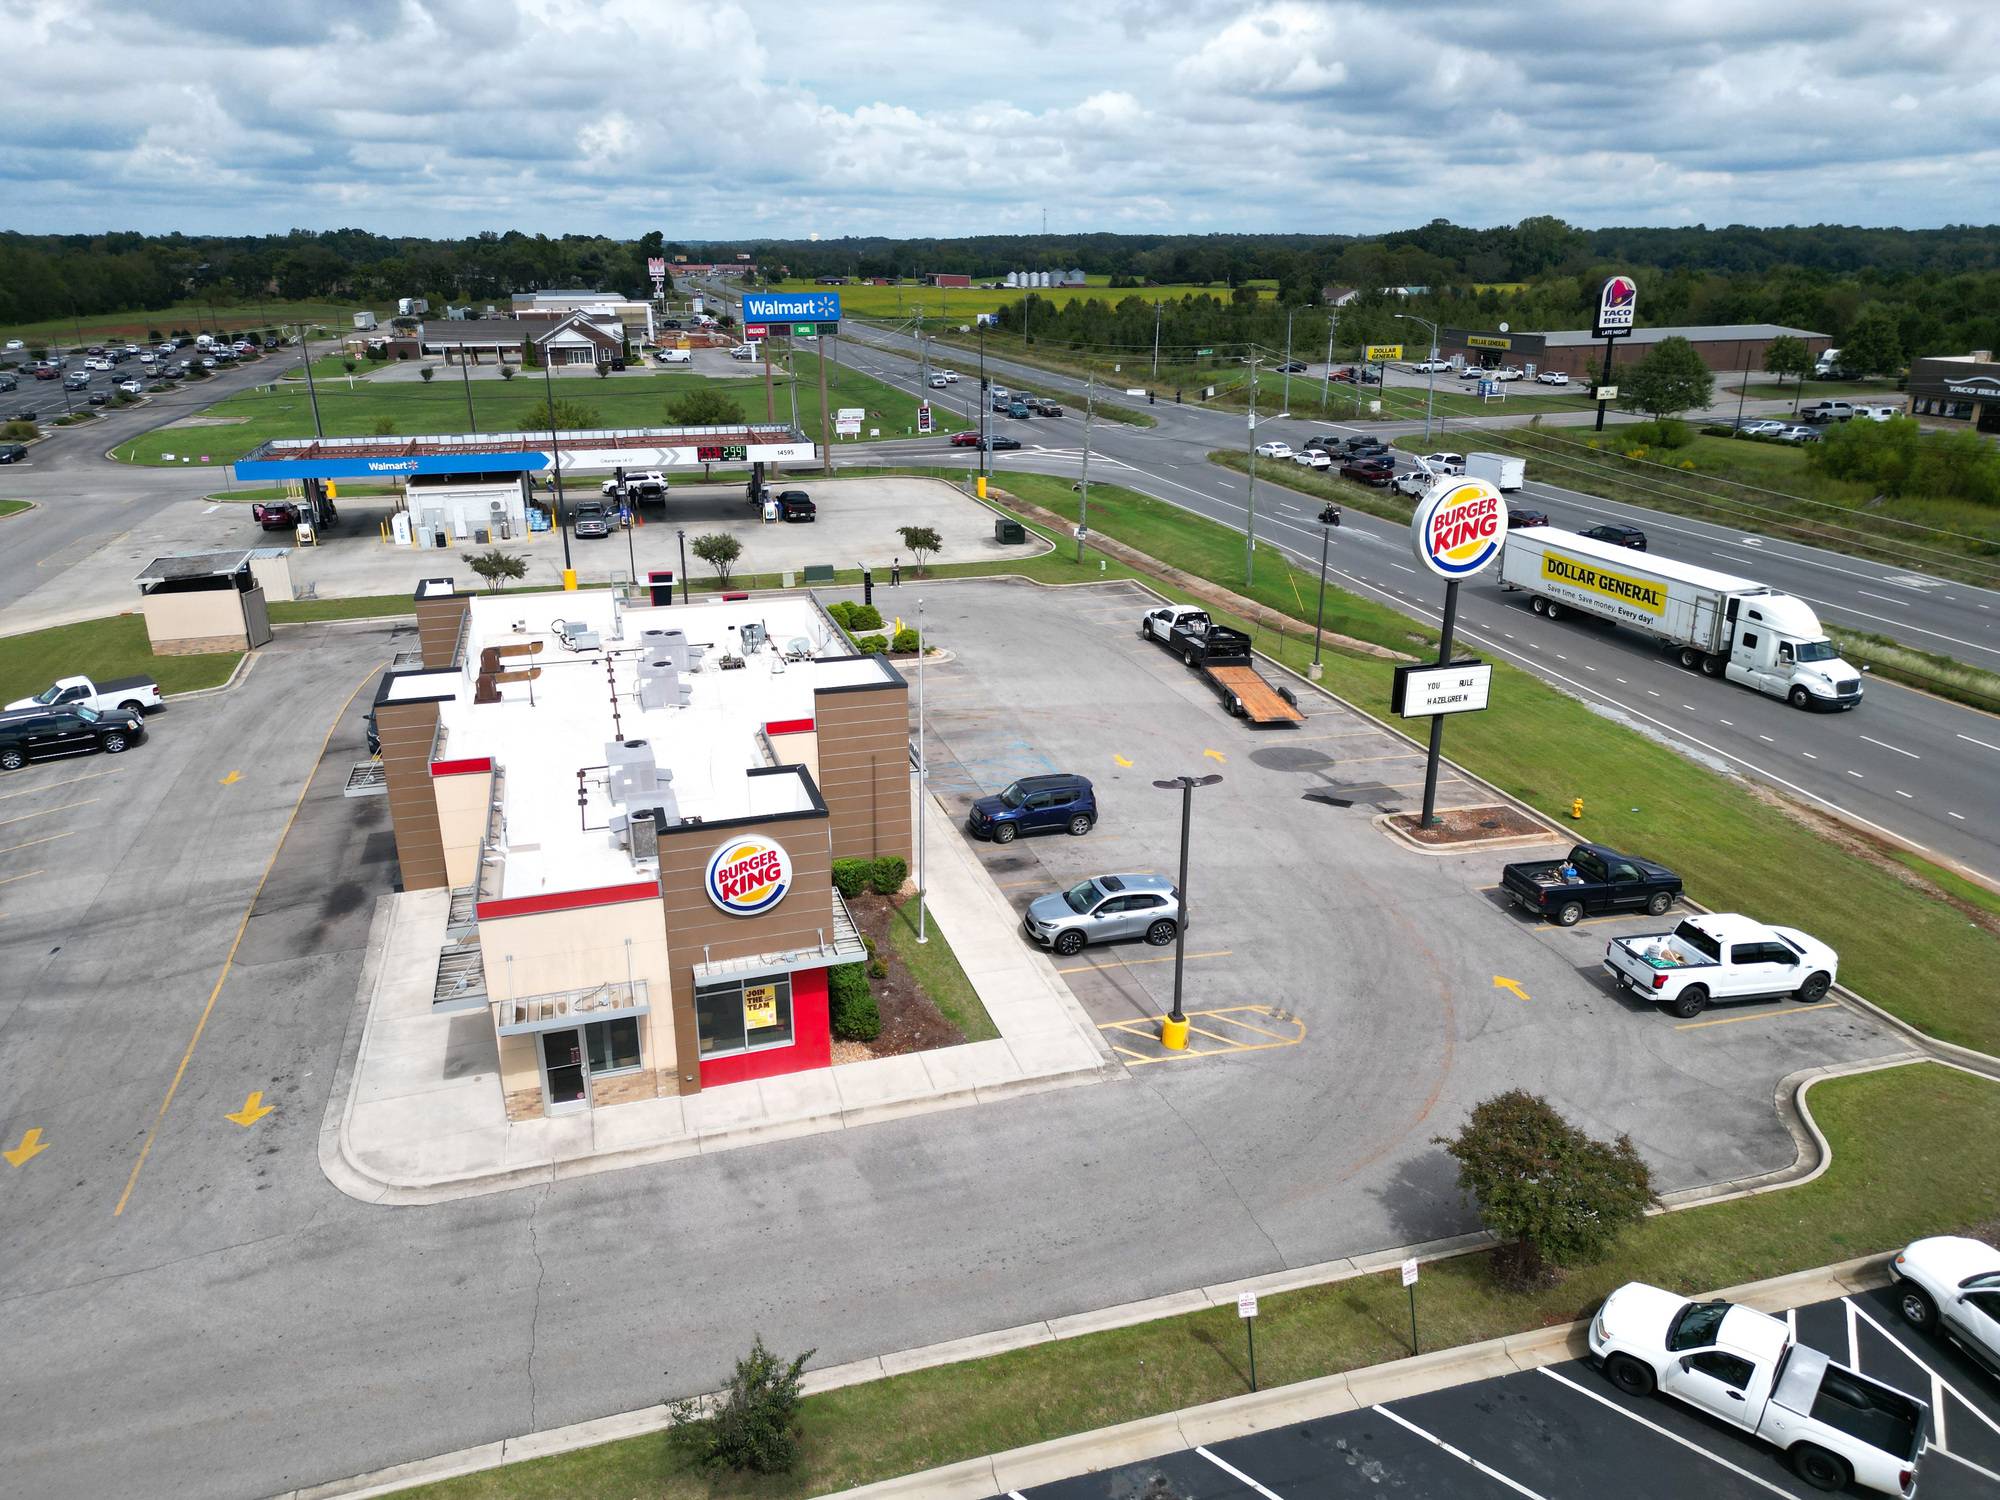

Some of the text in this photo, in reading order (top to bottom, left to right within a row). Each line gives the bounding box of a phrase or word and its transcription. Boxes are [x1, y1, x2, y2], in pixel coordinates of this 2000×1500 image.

[748, 299, 815, 315] Walmart
[1603, 309, 1632, 317] TACO
[1603, 317, 1631, 325] BELL
[1487, 340, 1507, 348] GENERAL
[1949, 385, 1976, 394] TACO
[368, 461, 408, 471] Walmart
[1433, 498, 1497, 533] BURGER
[1433, 513, 1498, 555] KING
[1547, 559, 1659, 607] DOLLAR GENERAL
[1547, 584, 1654, 625] Save time. Save money. Every day!
[1427, 679, 1474, 690] YOU RULE
[718, 850, 778, 884] BURGER
[722, 862, 781, 902] KING
[746, 988, 766, 998] JOIN
[746, 995, 763, 1005] THE
[747, 1002, 770, 1012] TEAM
